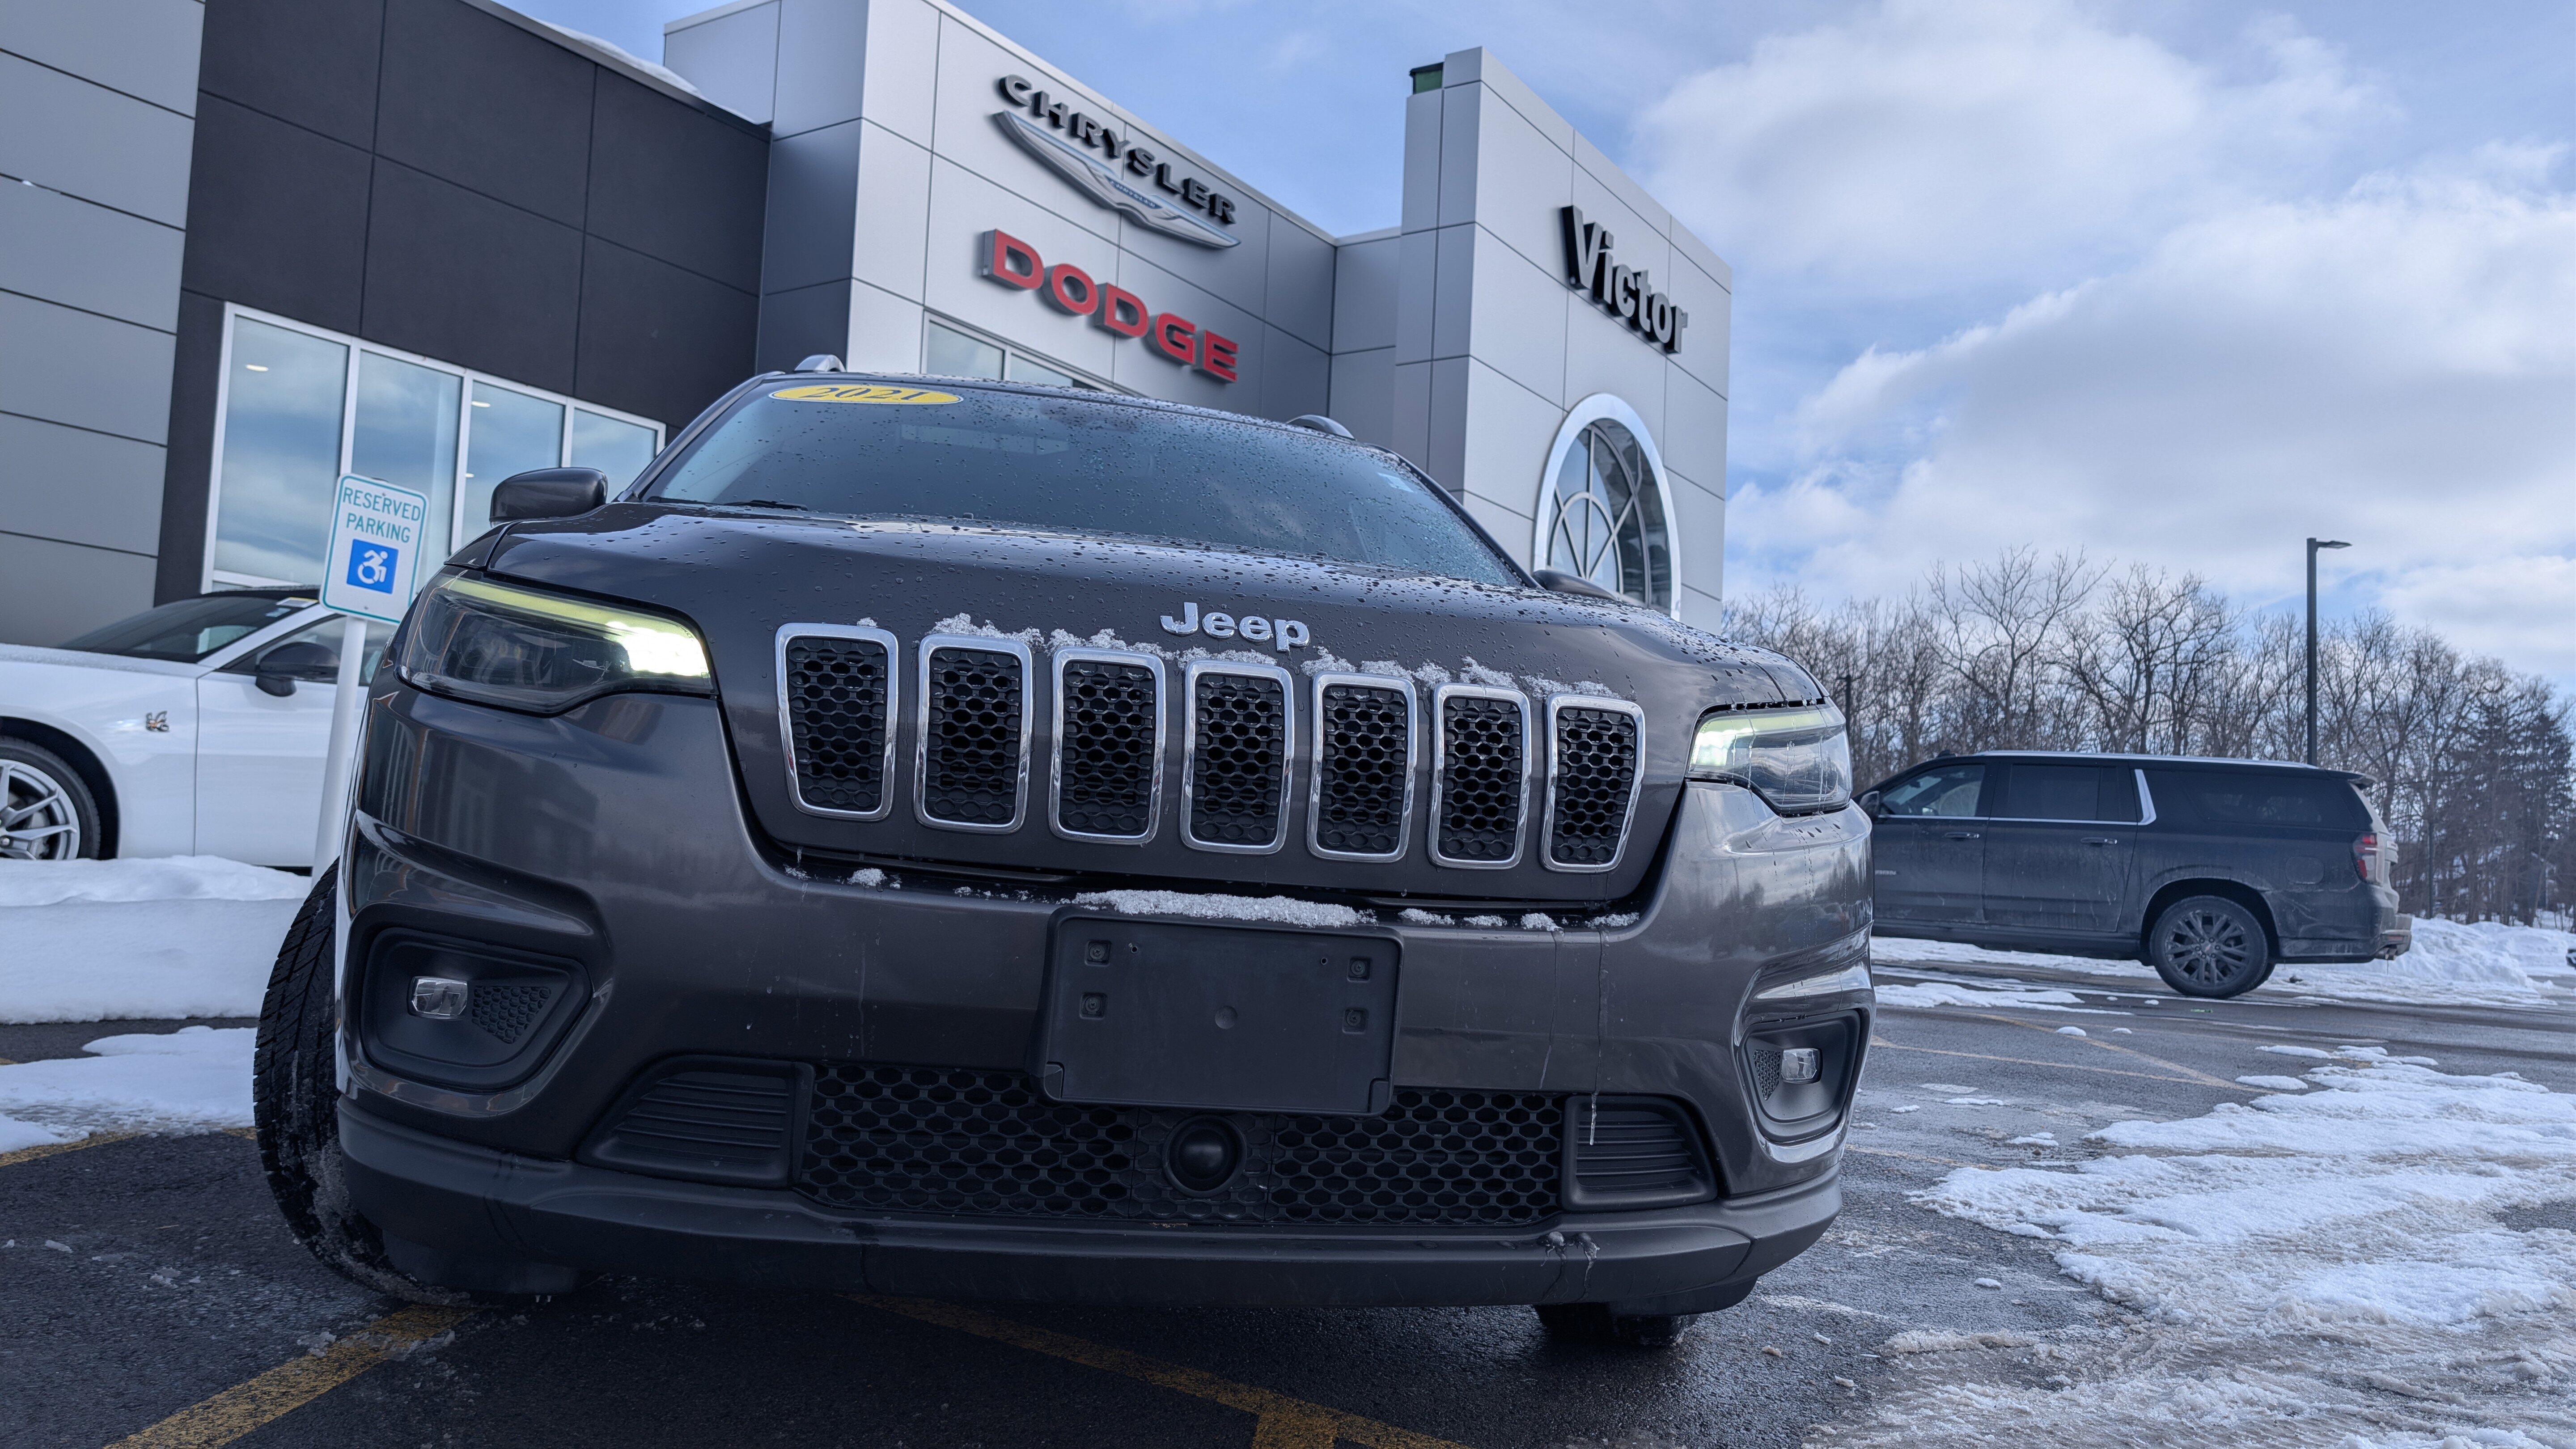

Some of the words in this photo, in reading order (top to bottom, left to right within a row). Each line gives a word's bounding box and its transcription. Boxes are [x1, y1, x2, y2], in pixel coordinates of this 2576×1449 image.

[1000, 74, 1236, 224] CHRYSLER
[1561, 205, 1688, 354] Victor
[984, 229, 1238, 382] DODGE
[799, 388, 929, 400] 2021
[343, 487, 421, 521] RESERVED
[346, 513, 411, 543] PARKING
[1160, 602, 1310, 652] Jeep
